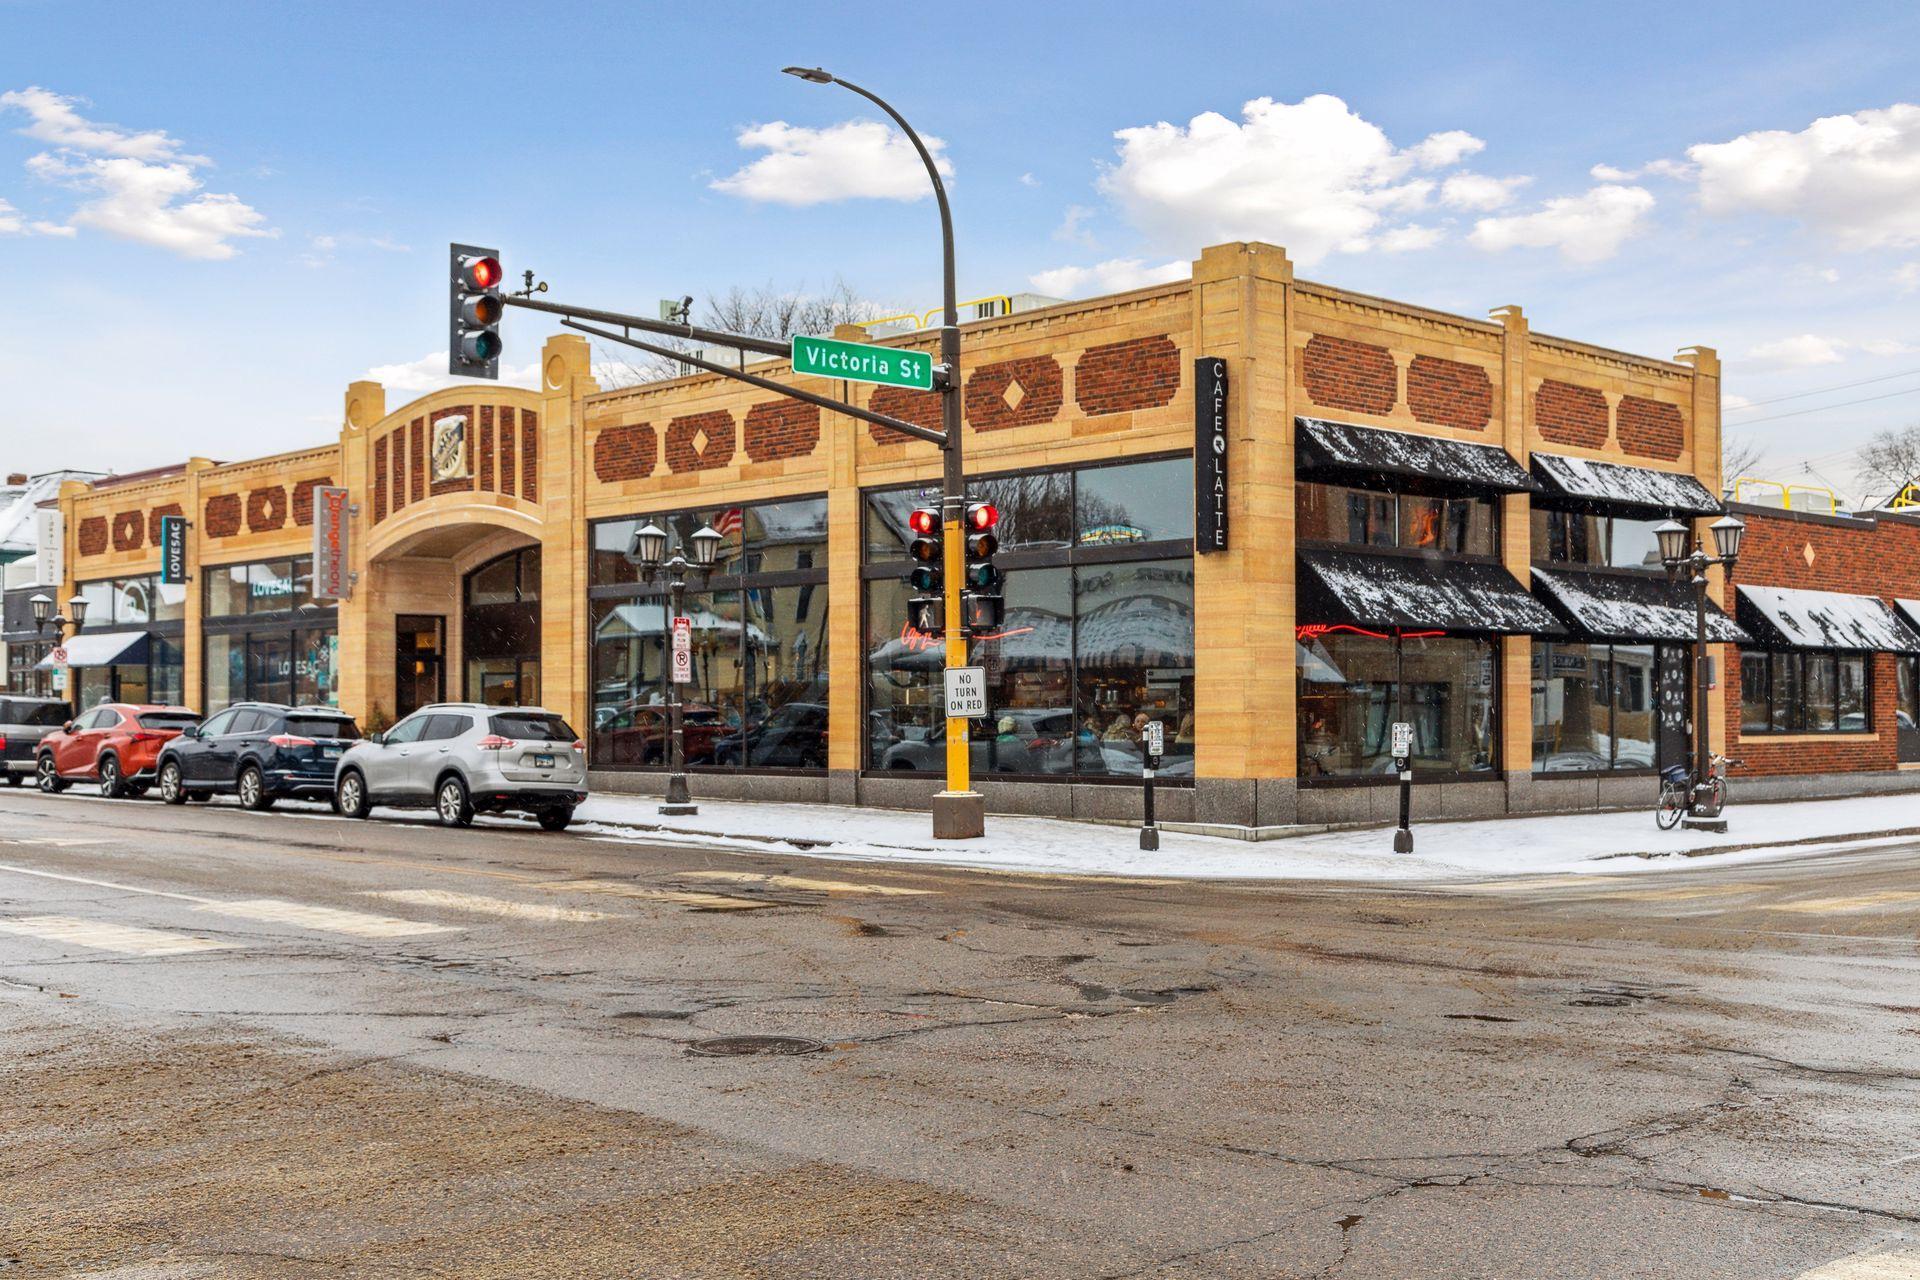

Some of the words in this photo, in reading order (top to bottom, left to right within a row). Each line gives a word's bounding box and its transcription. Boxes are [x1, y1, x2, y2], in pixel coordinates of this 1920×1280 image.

[805, 345, 889, 375] Victoria
[900, 358, 921, 379] St
[1213, 362, 1223, 432] CAFE
[1214, 458, 1224, 545] LATTE
[171, 522, 181, 579] LOVESAC
[278, 660, 321, 676] LOESAC
[959, 674, 972, 684] NO
[955, 687, 977, 697] TURN
[950, 701, 963, 711] ON
[966, 700, 983, 710] RED
